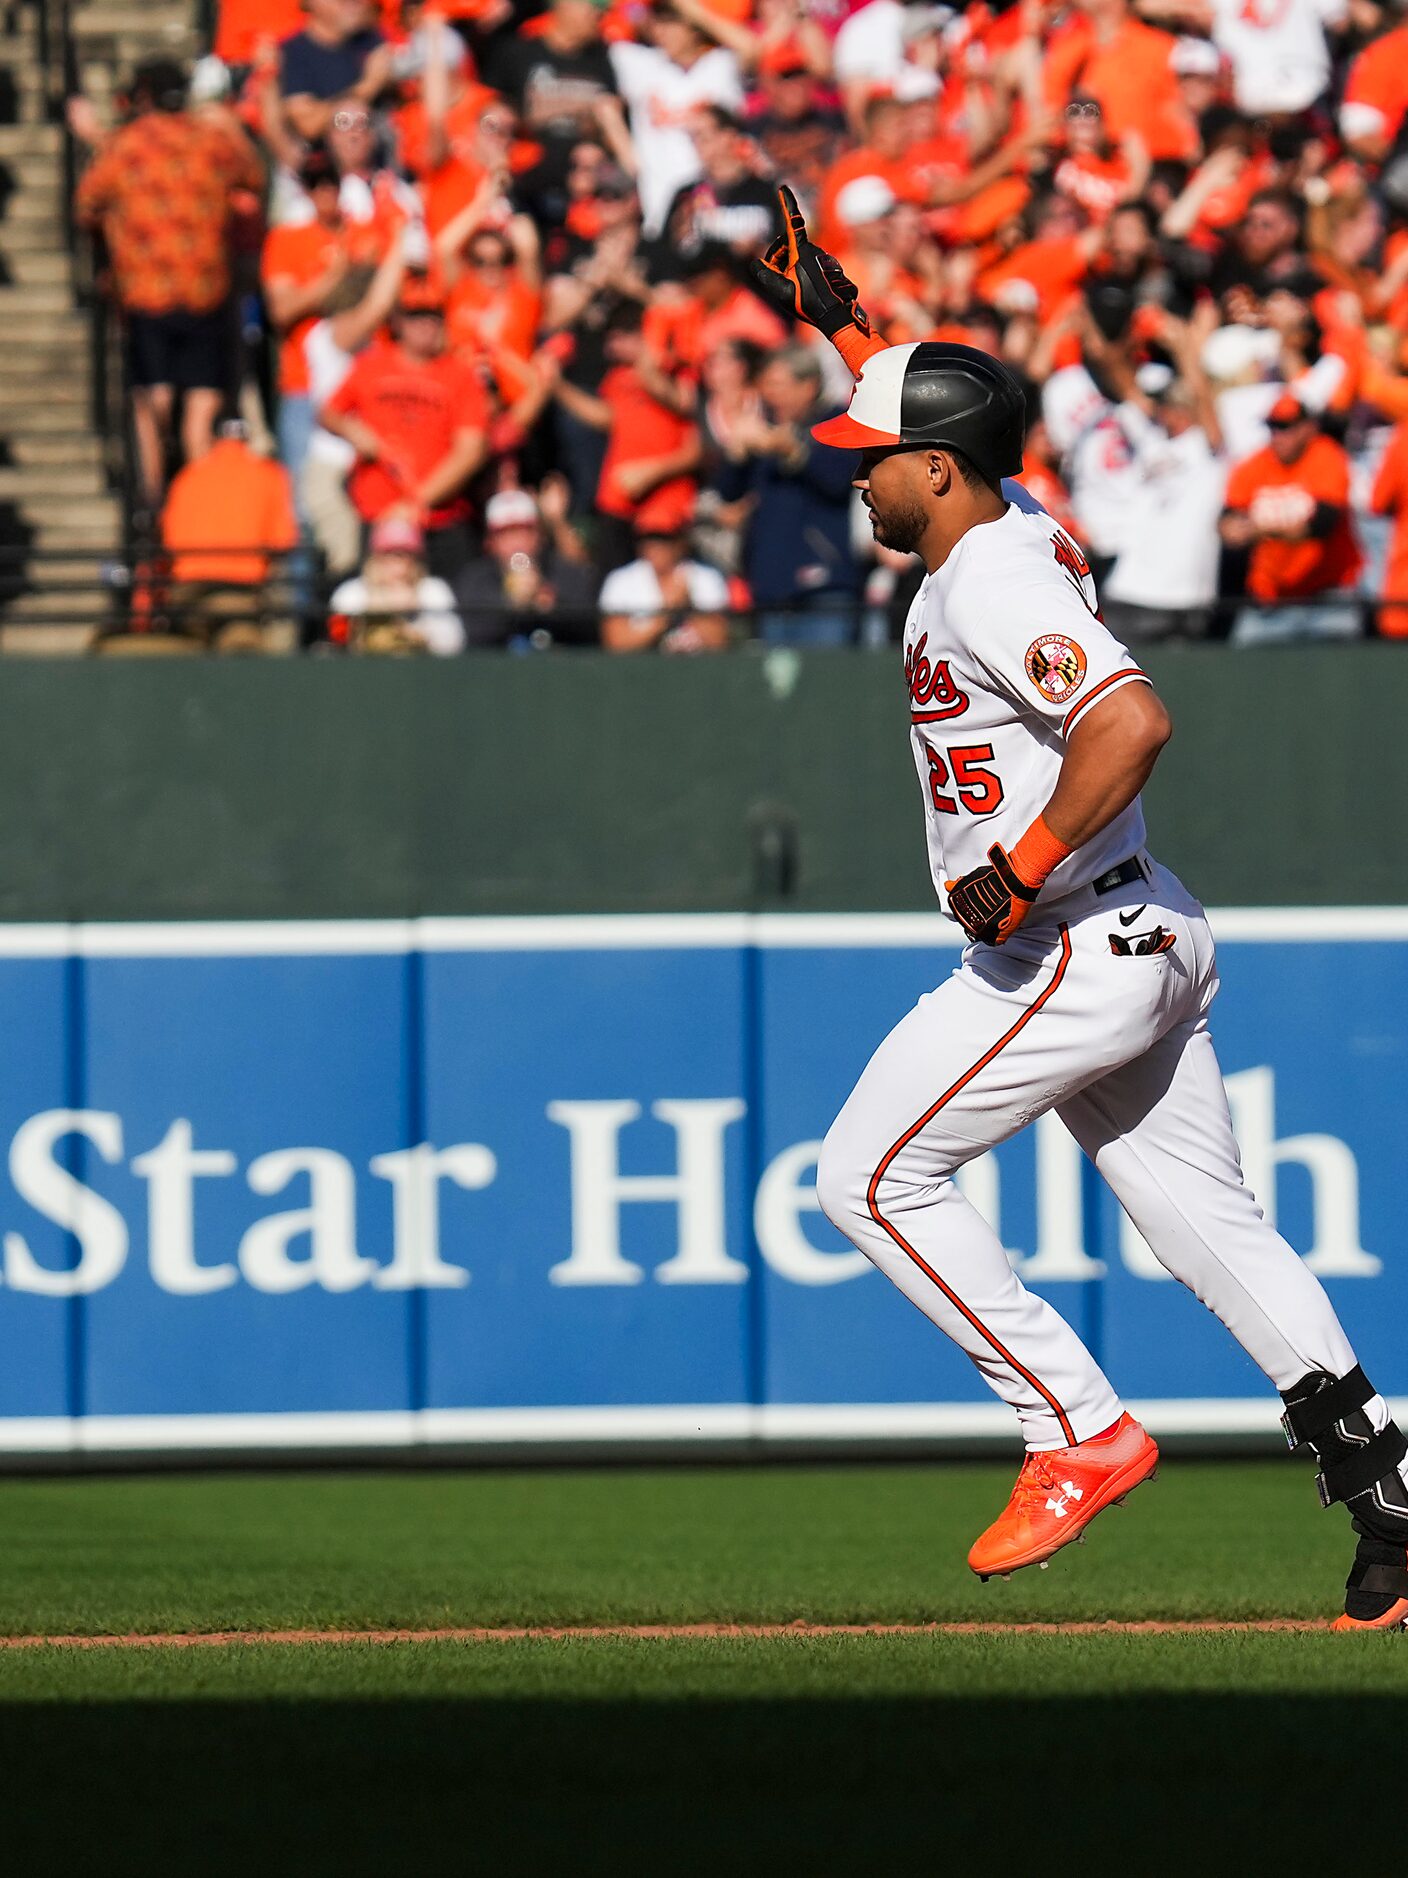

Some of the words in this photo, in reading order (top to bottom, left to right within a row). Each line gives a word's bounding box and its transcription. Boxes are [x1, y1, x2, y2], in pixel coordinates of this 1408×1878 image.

[905, 631, 969, 710] les
[1025, 635, 1073, 678] BALTIMORE
[1052, 669, 1086, 702] ORIOLES
[925, 742, 1004, 816] 25
[0, 1107, 498, 1298] Star
[547, 1066, 1384, 1286] Helh
